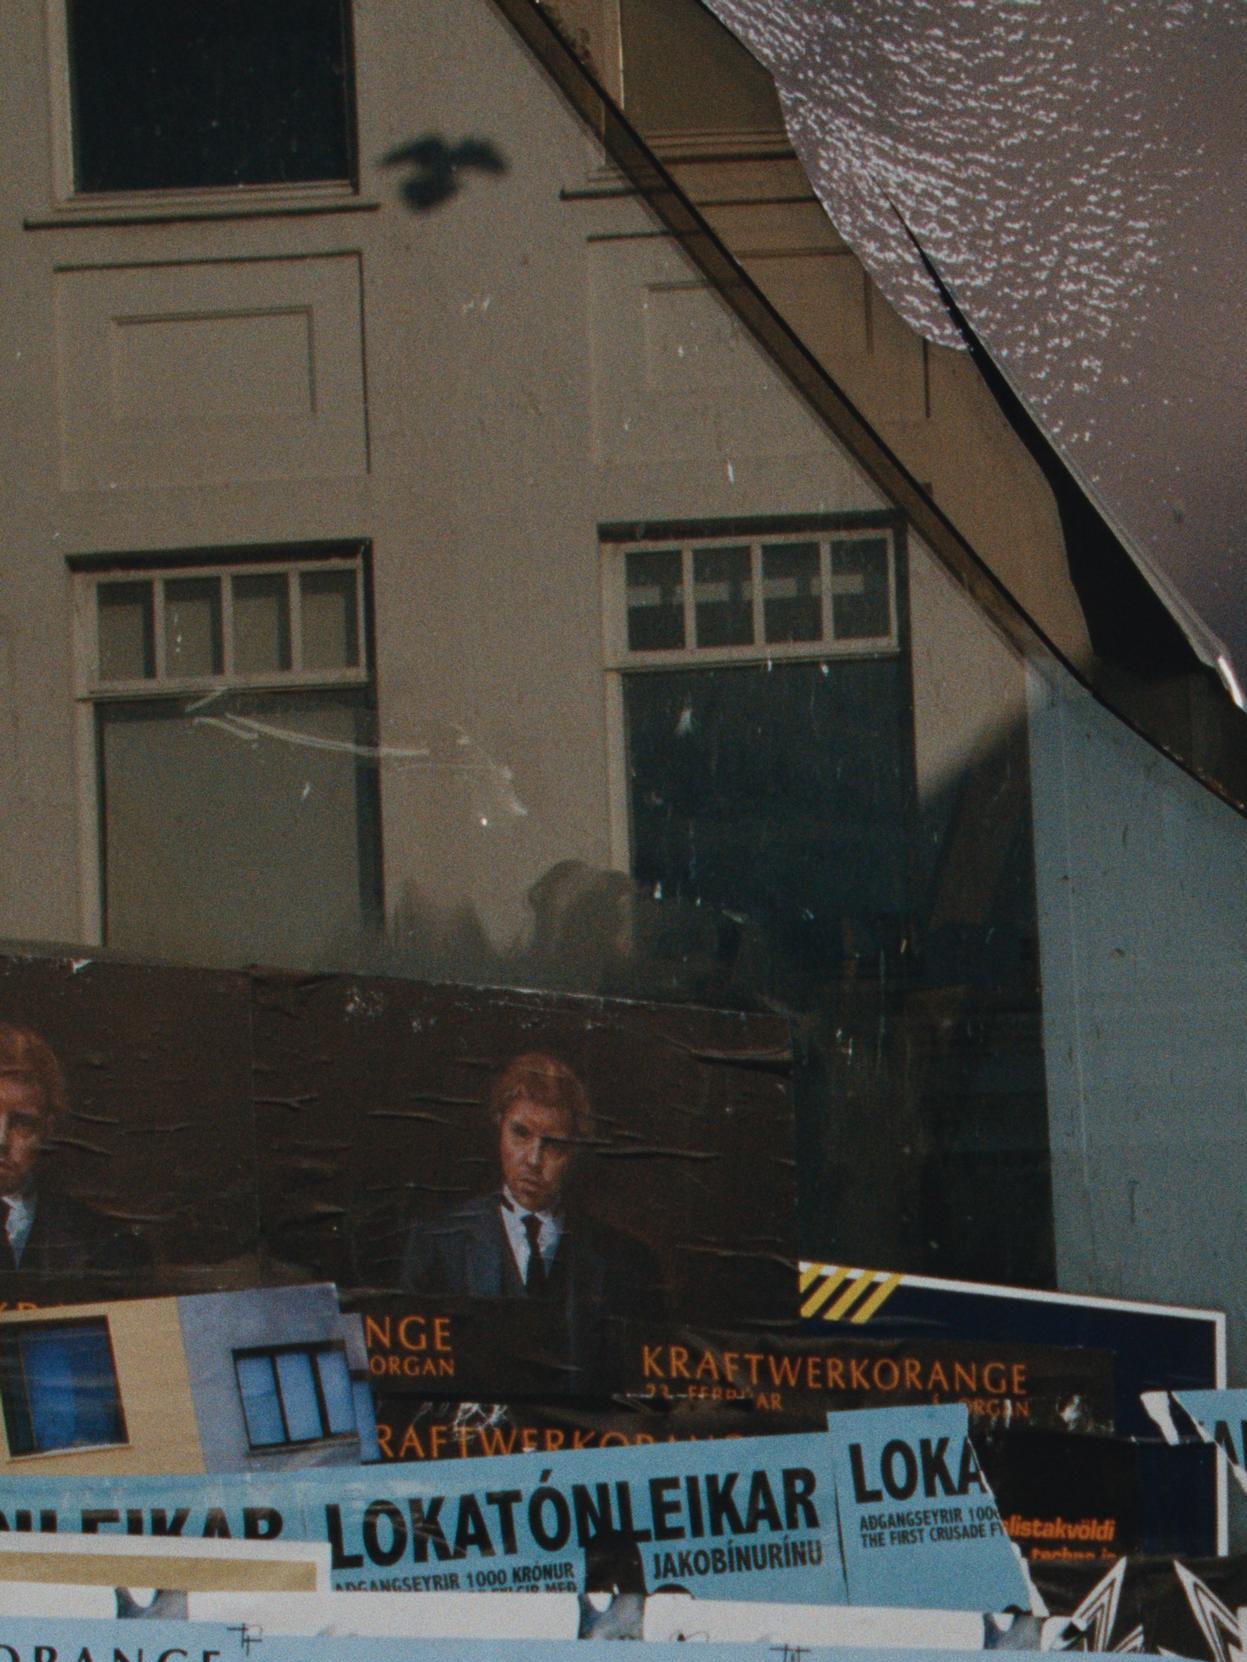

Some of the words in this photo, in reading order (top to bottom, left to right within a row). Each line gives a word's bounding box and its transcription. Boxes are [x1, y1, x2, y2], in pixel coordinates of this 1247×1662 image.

[641, 1343, 1028, 1396] KRAFTWERKORANGE
[860, 1532, 885, 1549] THE
[891, 1526, 926, 1546] FIRST
[930, 1523, 986, 1542] CRUSADE
[466, 1569, 507, 1587] 1000
[512, 1561, 575, 1582] KRÓNUR
[653, 1539, 823, 1580] JAKOBÍNURÍNU
